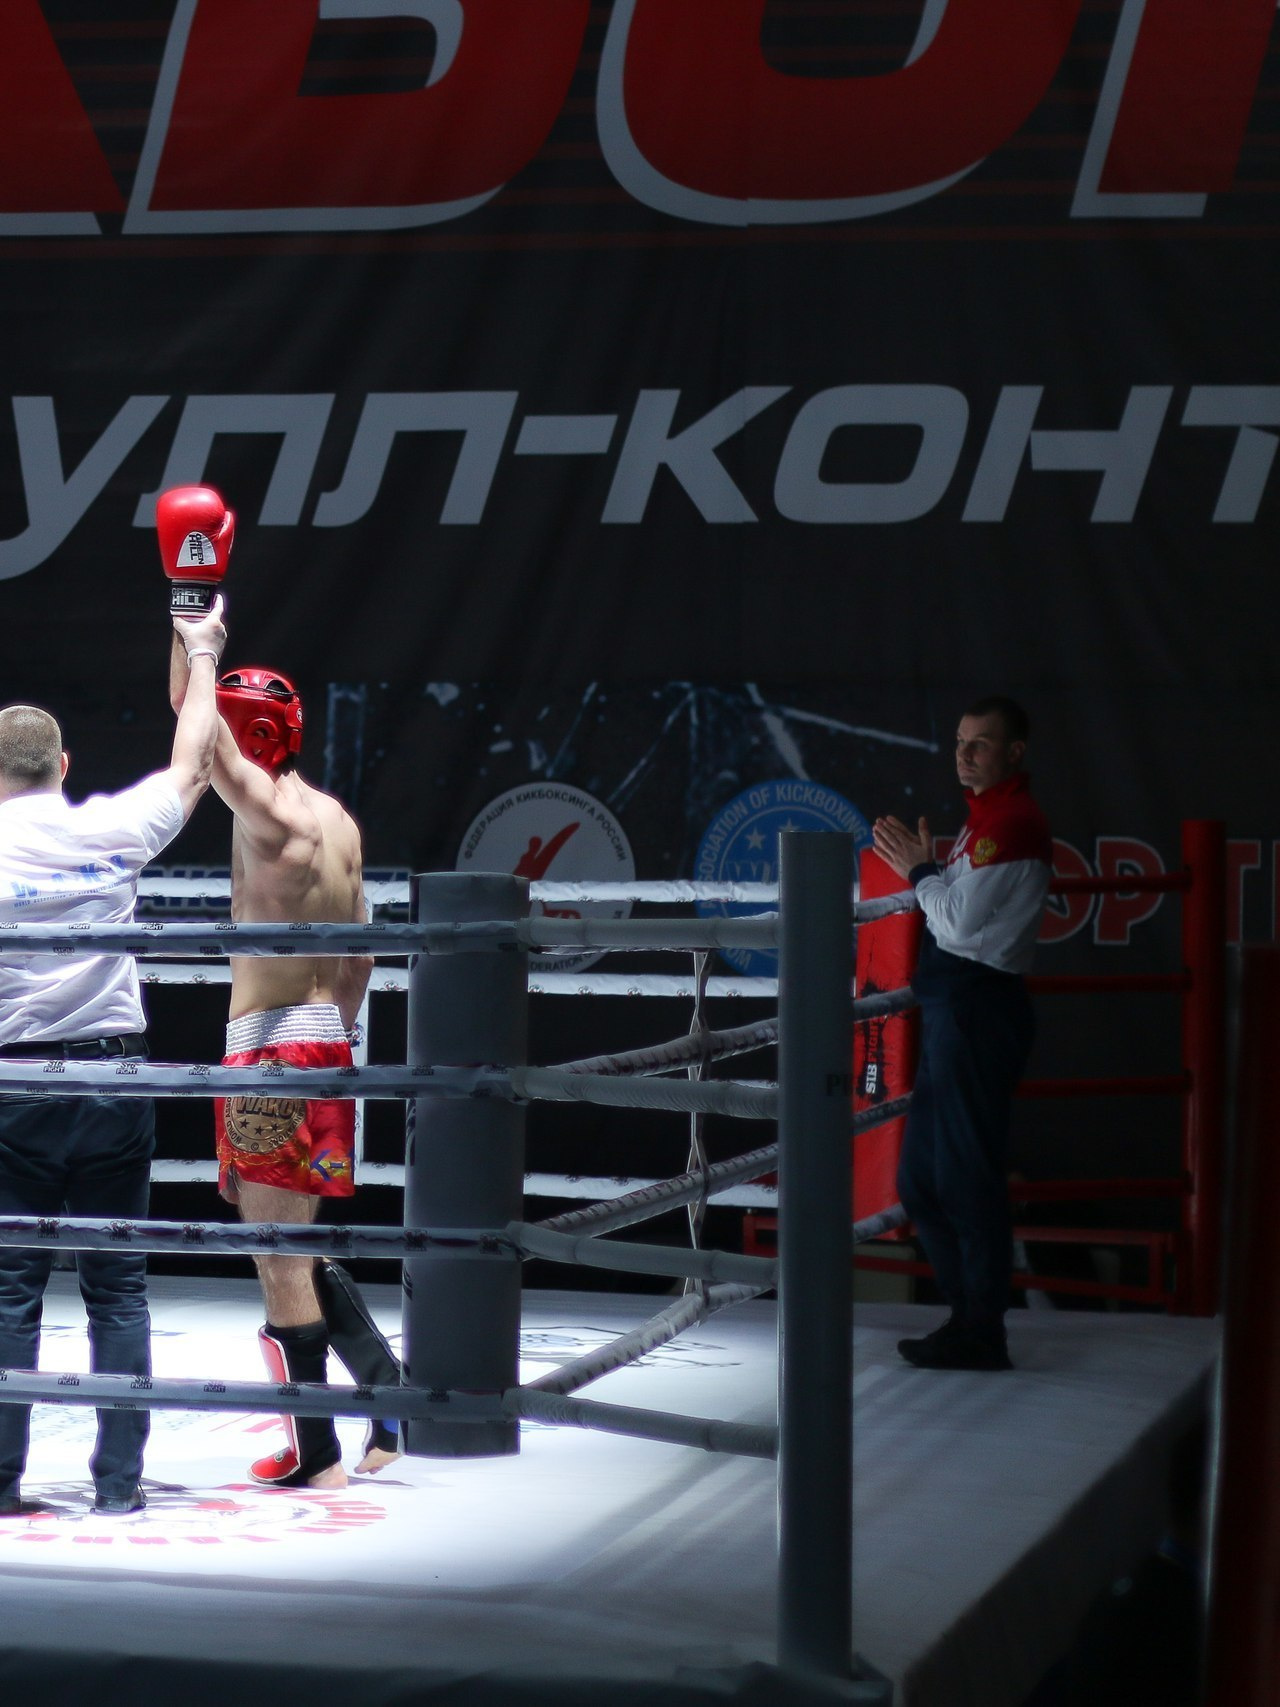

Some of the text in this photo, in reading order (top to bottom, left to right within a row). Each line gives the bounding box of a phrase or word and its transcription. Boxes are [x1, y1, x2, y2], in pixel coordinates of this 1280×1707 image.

[188, 534, 197, 561] HILL
[171, 587, 210, 597] GREEN
[172, 596, 205, 606] HILL
[464, 788, 627, 862] ФЕДЕРАЦИЯ КИКБОКСИНГА РОССИИ
[748, 787, 771, 809] OF
[776, 783, 868, 842] KICKBOXING
[865, 1063, 878, 1094] SIB
[235, 1097, 296, 1119] WAKO
